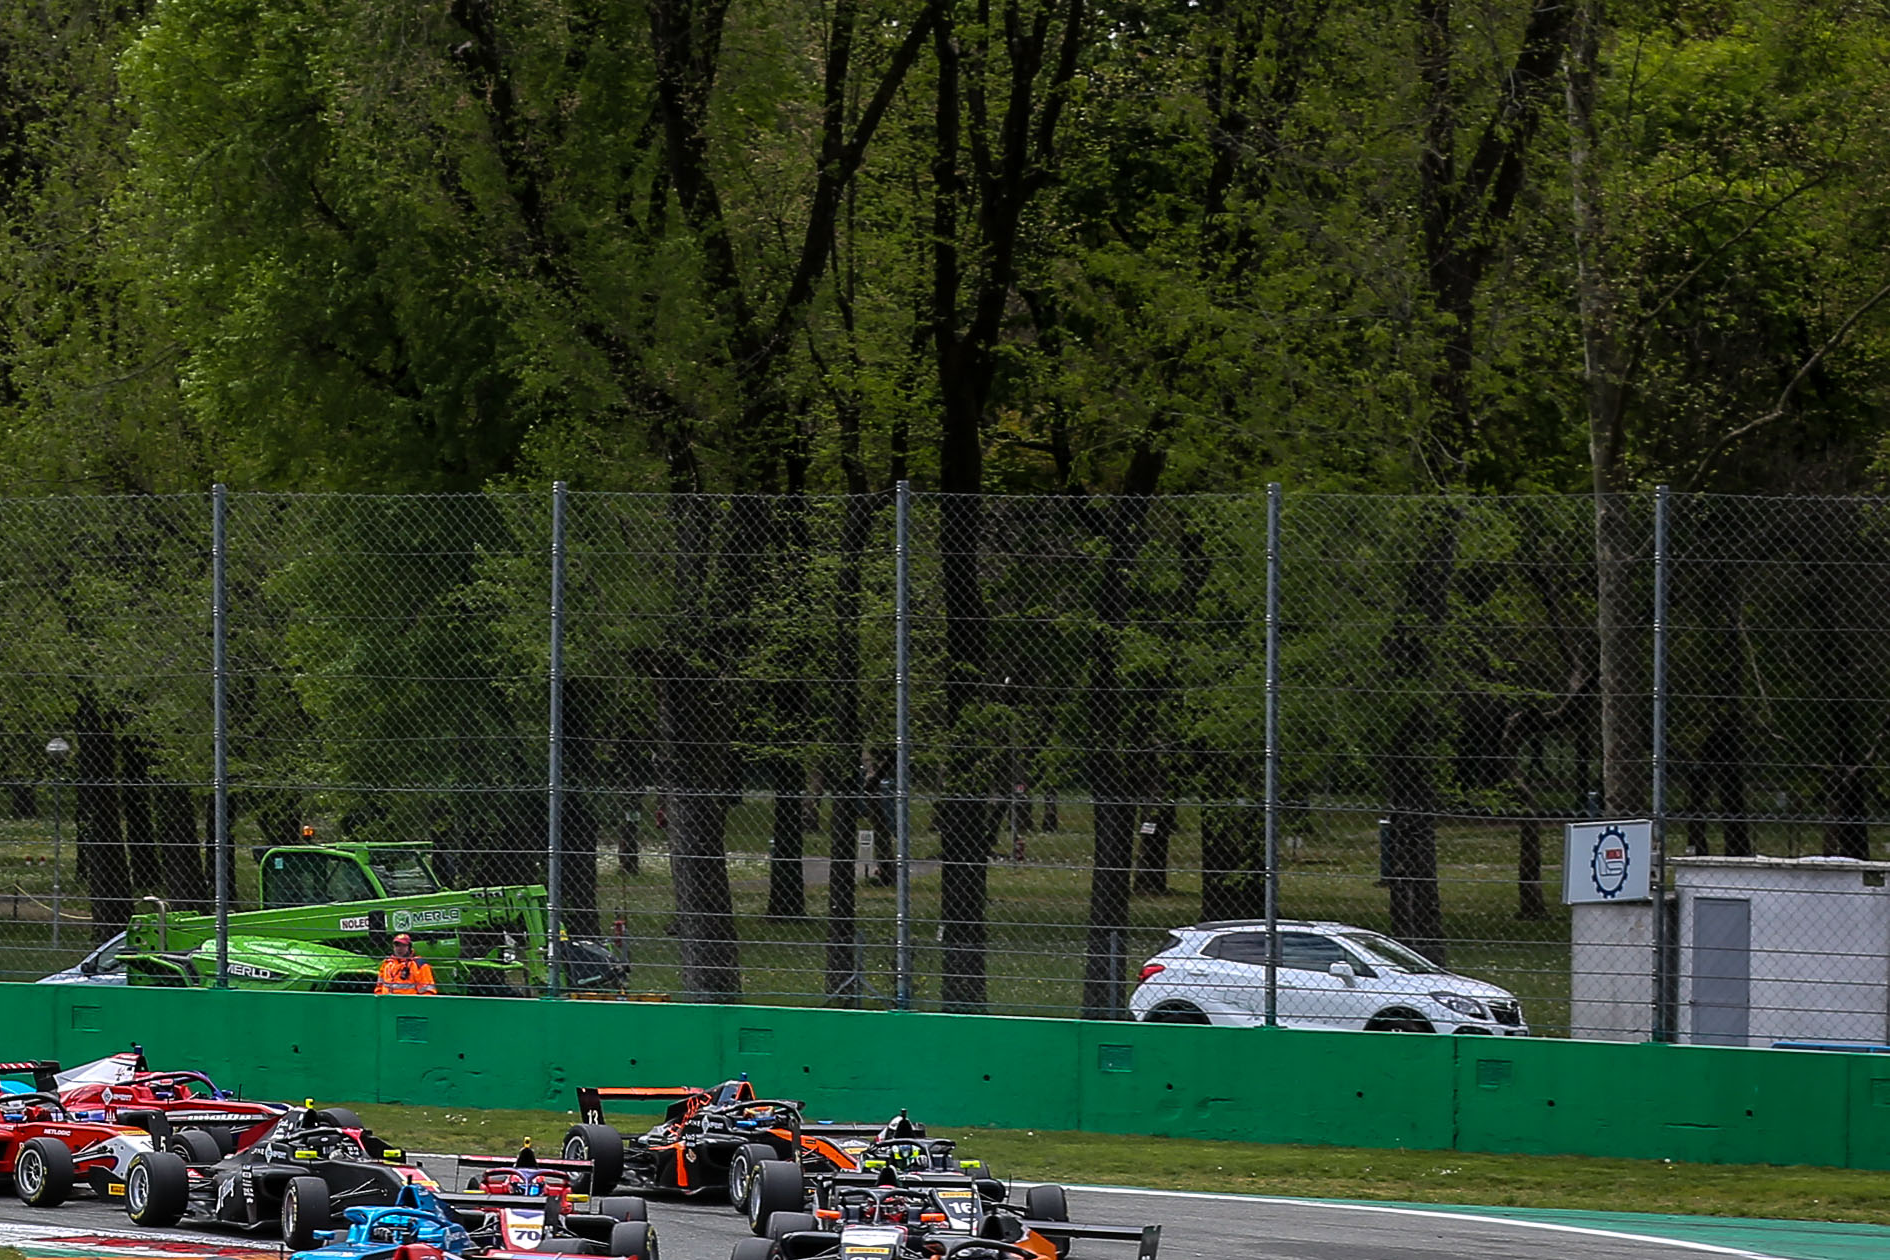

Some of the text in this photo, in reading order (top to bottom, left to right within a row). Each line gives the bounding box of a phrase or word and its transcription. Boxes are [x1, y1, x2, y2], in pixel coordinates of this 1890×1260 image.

[413, 908, 459, 922] MERLO
[948, 1201, 978, 1214] 16
[514, 1230, 541, 1241] 70
